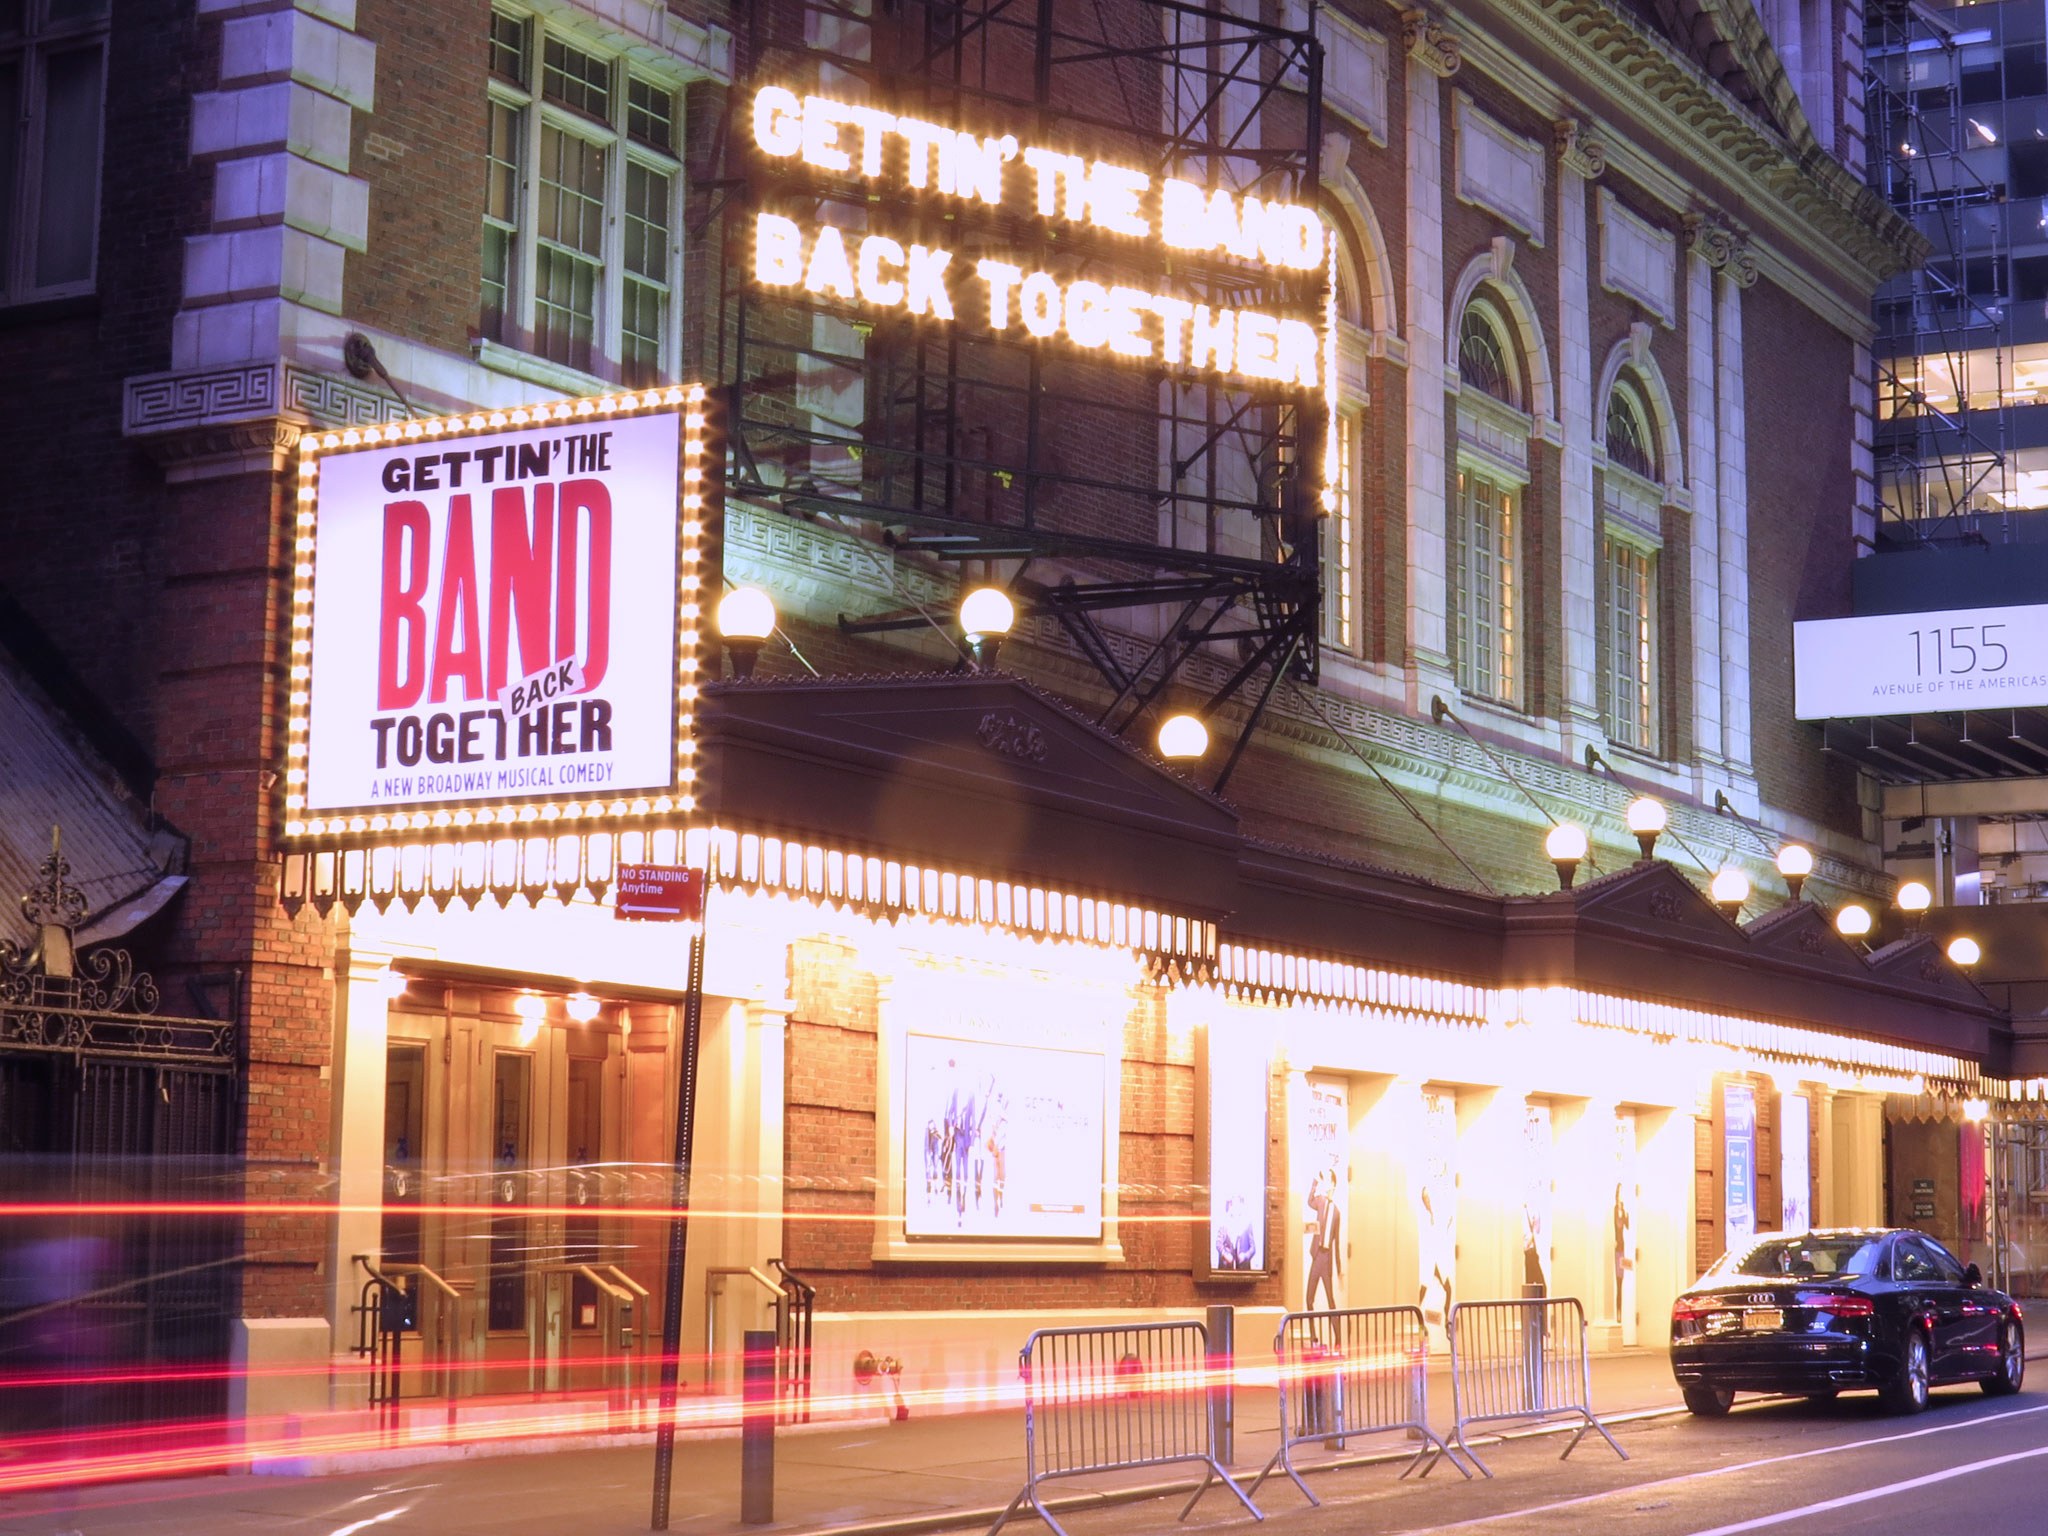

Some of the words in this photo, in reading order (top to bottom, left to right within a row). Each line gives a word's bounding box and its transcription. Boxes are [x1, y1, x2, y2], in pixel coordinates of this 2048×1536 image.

[752, 85, 1018, 205] GETTIN'
[1024, 146, 1150, 237] THE
[1162, 178, 1325, 270] BAND
[755, 212, 954, 320] BACK
[977, 258, 1319, 388] TOGETHER
[382, 439, 560, 493] GETTIN'
[565, 431, 613, 475] THE
[378, 478, 612, 711] BAND
[1908, 624, 2008, 676] 1155
[511, 660, 575, 716] BACK
[1872, 682, 1923, 696] AVENUE
[1928, 681, 1944, 693] OF
[1950, 679, 1973, 691] THE
[1979, 675, 2047, 689] AMERICAS
[370, 698, 612, 769] TOGETHER
[371, 780, 380, 798] A
[384, 777, 413, 797] NEW
[418, 771, 493, 794] BROADWAY
[498, 767, 554, 789] MUSICAL
[559, 762, 614, 784] COMEDY
[621, 868, 636, 879] NO
[638, 869, 689, 883] STANDING
[621, 881, 664, 896] Anytime
